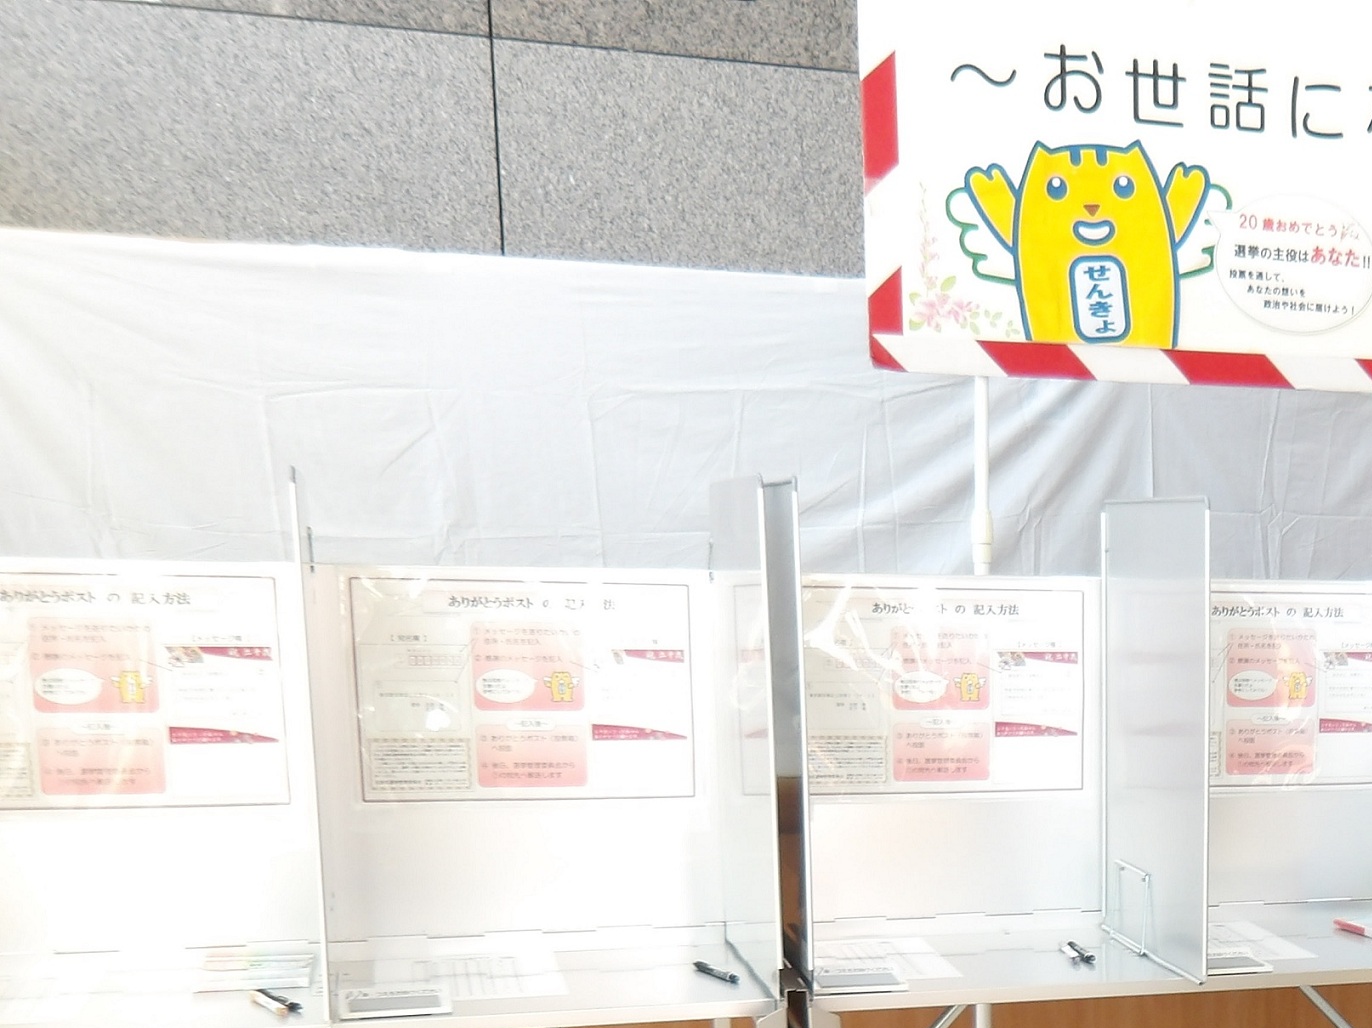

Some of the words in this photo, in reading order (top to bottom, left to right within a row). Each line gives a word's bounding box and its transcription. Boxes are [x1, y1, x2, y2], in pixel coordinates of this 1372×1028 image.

[1082, 264, 1117, 334] せんきょ
[107, 592, 121, 603] の
[131, 591, 192, 606] 記入方法
[448, 595, 534, 609] ありがとうポスト
[954, 604, 967, 614] の
[973, 603, 1021, 616] 記入方法
[1211, 605, 1281, 618] ありがとうポスト
[1286, 606, 1297, 617] の
[1303, 606, 1344, 618] 記入方法
